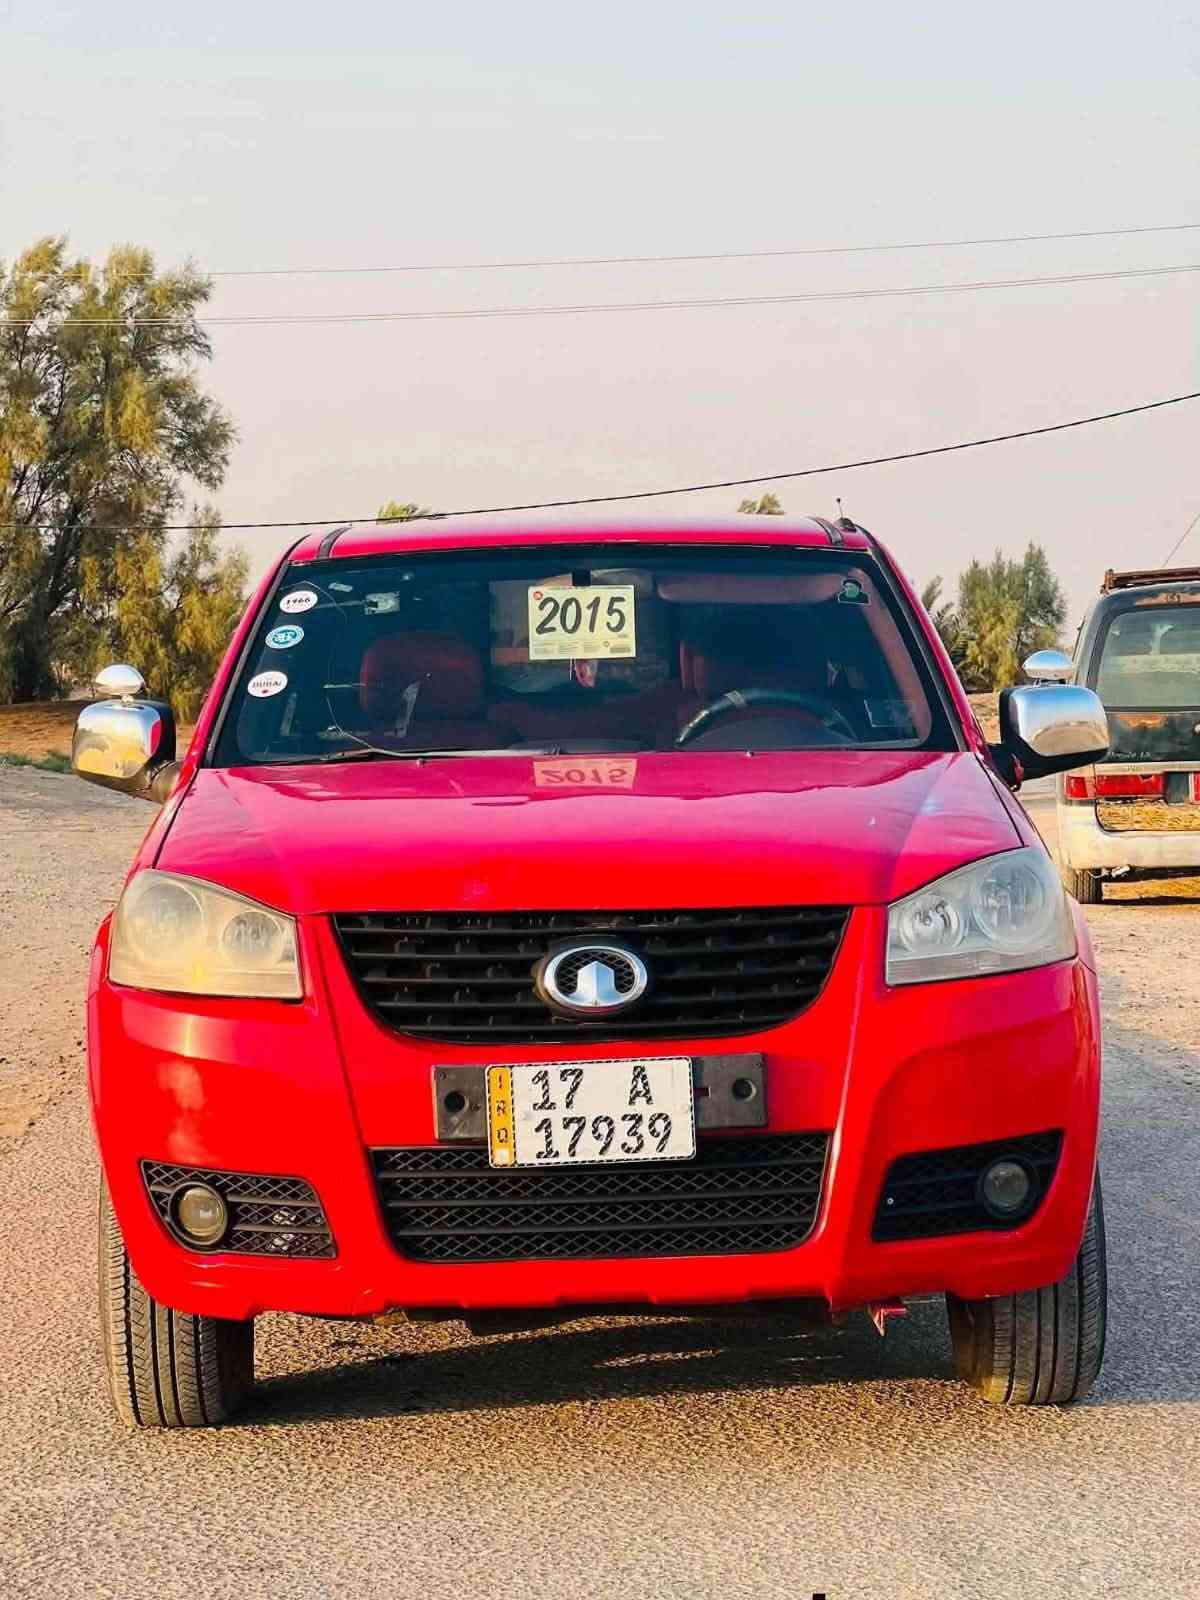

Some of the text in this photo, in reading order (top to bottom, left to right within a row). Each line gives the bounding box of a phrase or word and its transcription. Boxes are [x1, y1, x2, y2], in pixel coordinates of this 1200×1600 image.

[535, 596, 626, 635] 2015
[532, 1065, 654, 1111] 17 A
[534, 1112, 672, 1159] 17939
